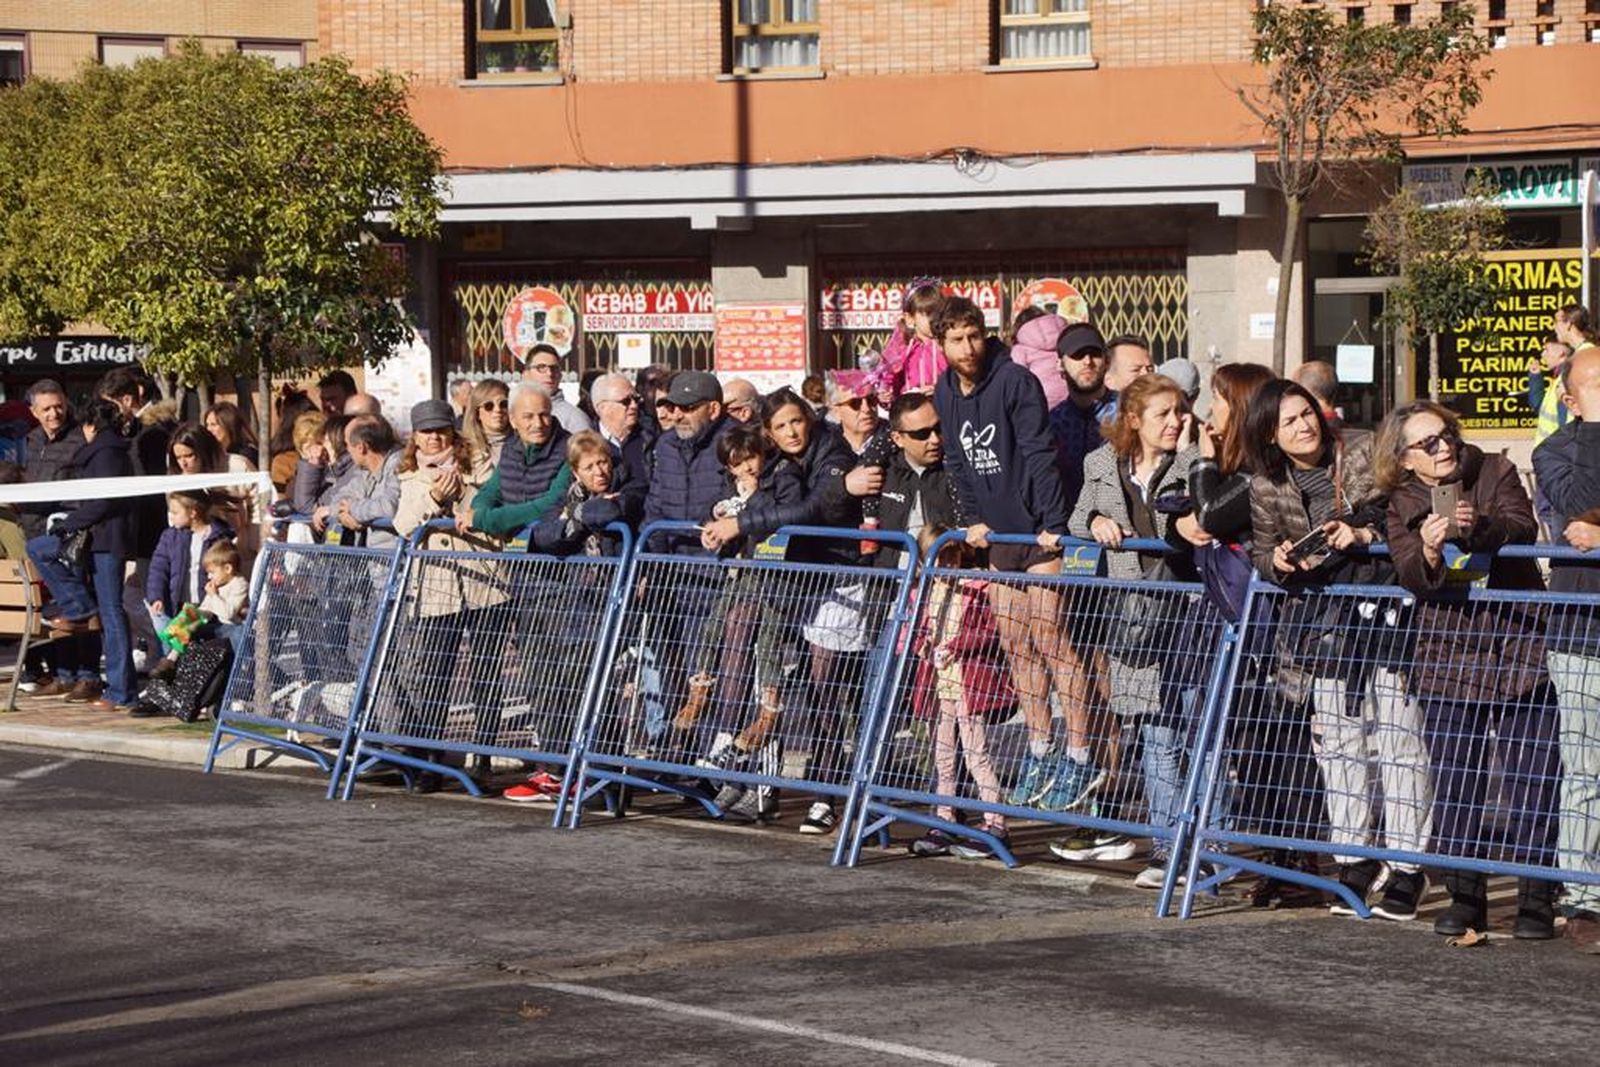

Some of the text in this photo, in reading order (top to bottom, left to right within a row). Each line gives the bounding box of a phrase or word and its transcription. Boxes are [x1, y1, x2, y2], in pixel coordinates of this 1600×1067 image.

[1468, 260, 1582, 290] ORMAS
[585, 292, 714, 314] KEBAB LA VIA
[821, 288, 901, 311] KEBAB
[586, 315, 627, 329] SERVICIO
[630, 316, 637, 328] A
[639, 315, 685, 329] DOMICILIO
[820, 313, 873, 328] SERVICIO
[877, 313, 885, 326] A
[1439, 314, 1556, 333] ONTANER
